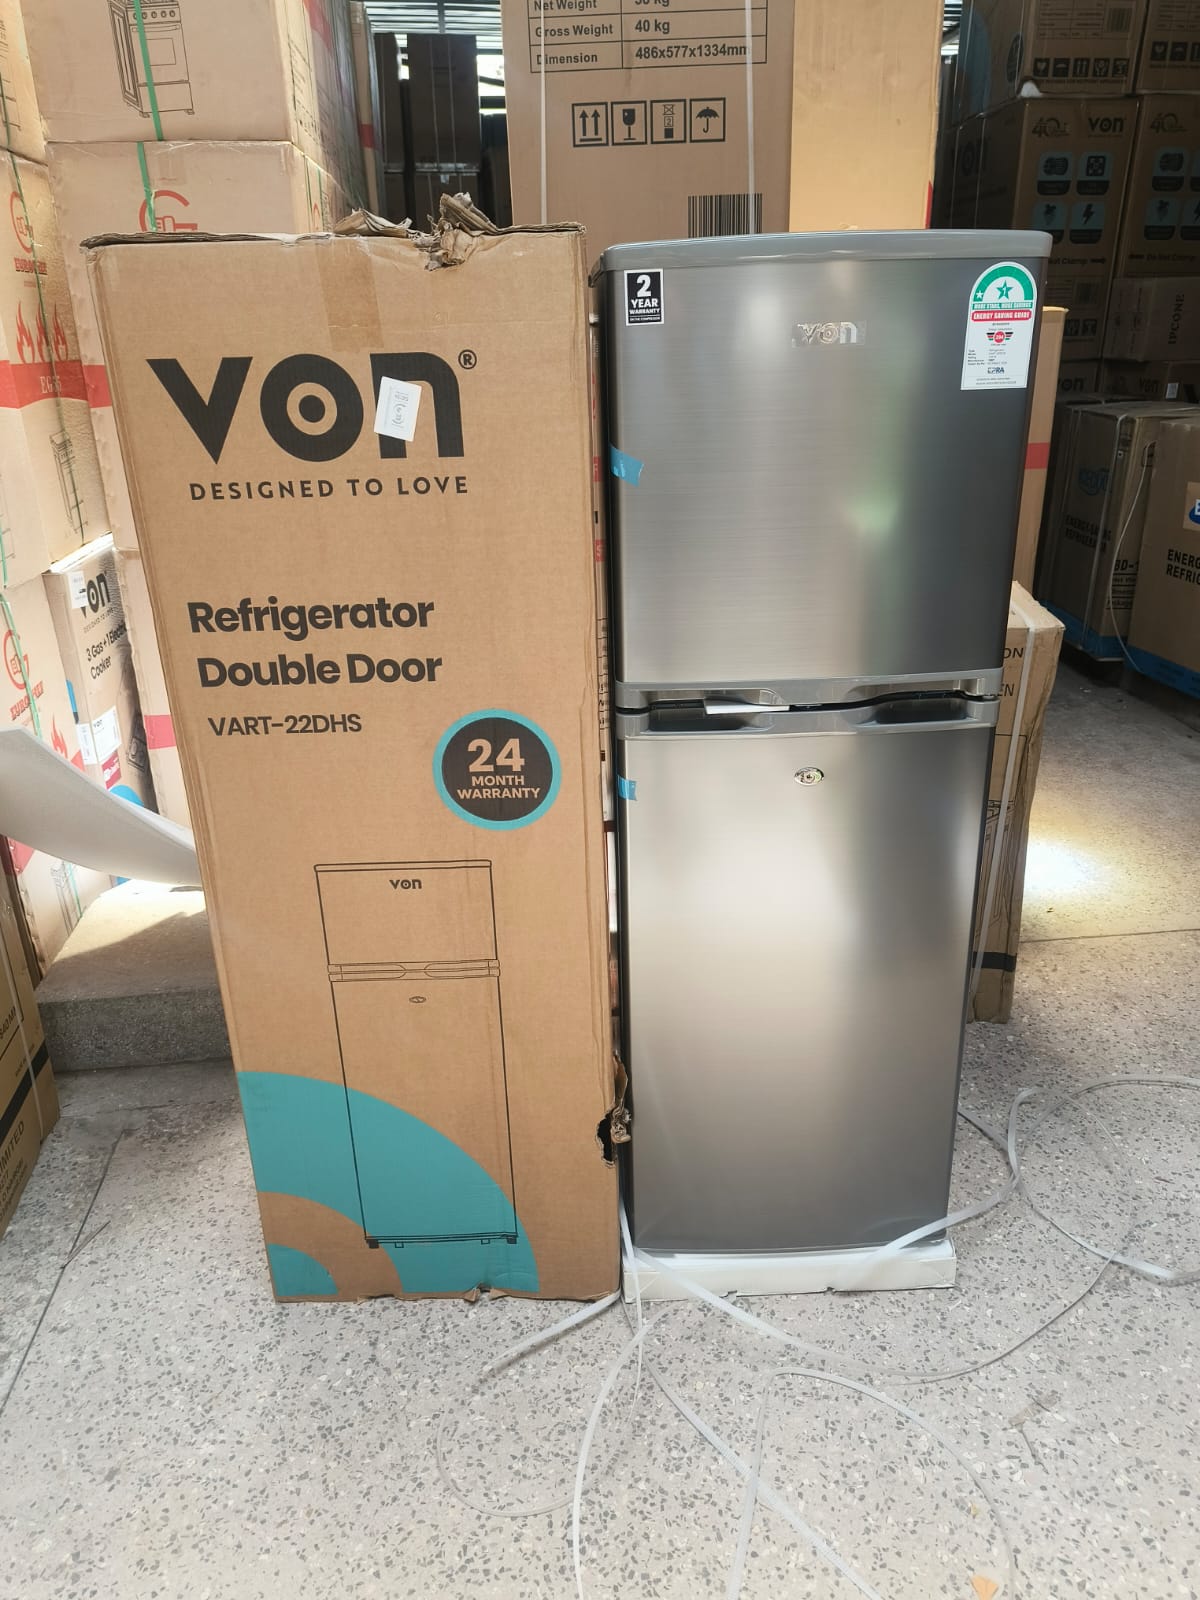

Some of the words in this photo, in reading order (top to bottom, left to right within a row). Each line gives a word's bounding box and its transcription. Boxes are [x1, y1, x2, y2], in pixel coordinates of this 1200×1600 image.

[557, 0, 597, 11] Weight
[535, 26, 570, 37] Gross
[572, 24, 613, 37] Weight
[635, 20, 650, 32] 40
[654, 19, 670, 34] kg
[636, 274, 651, 297] 2
[631, 298, 658, 308] YEAR
[973, 312, 993, 320] ENERGY
[797, 321, 857, 344] von
[190, 480, 333, 500] DESIGNED
[347, 478, 382, 496] TO
[397, 476, 468, 495] LOVE
[187, 595, 434, 641] Refrigerator
[85, 648, 91, 662] 3
[91, 642, 104, 659] Gas
[90, 655, 112, 680] Cooker
[197, 654, 341, 687] Double
[346, 653, 442, 683] Door
[208, 713, 362, 736] VART-22DHS
[467, 738, 525, 773] 24
[471, 775, 525, 787] MONTH
[457, 787, 540, 799] WARRANTY
[389, 879, 422, 890] von
